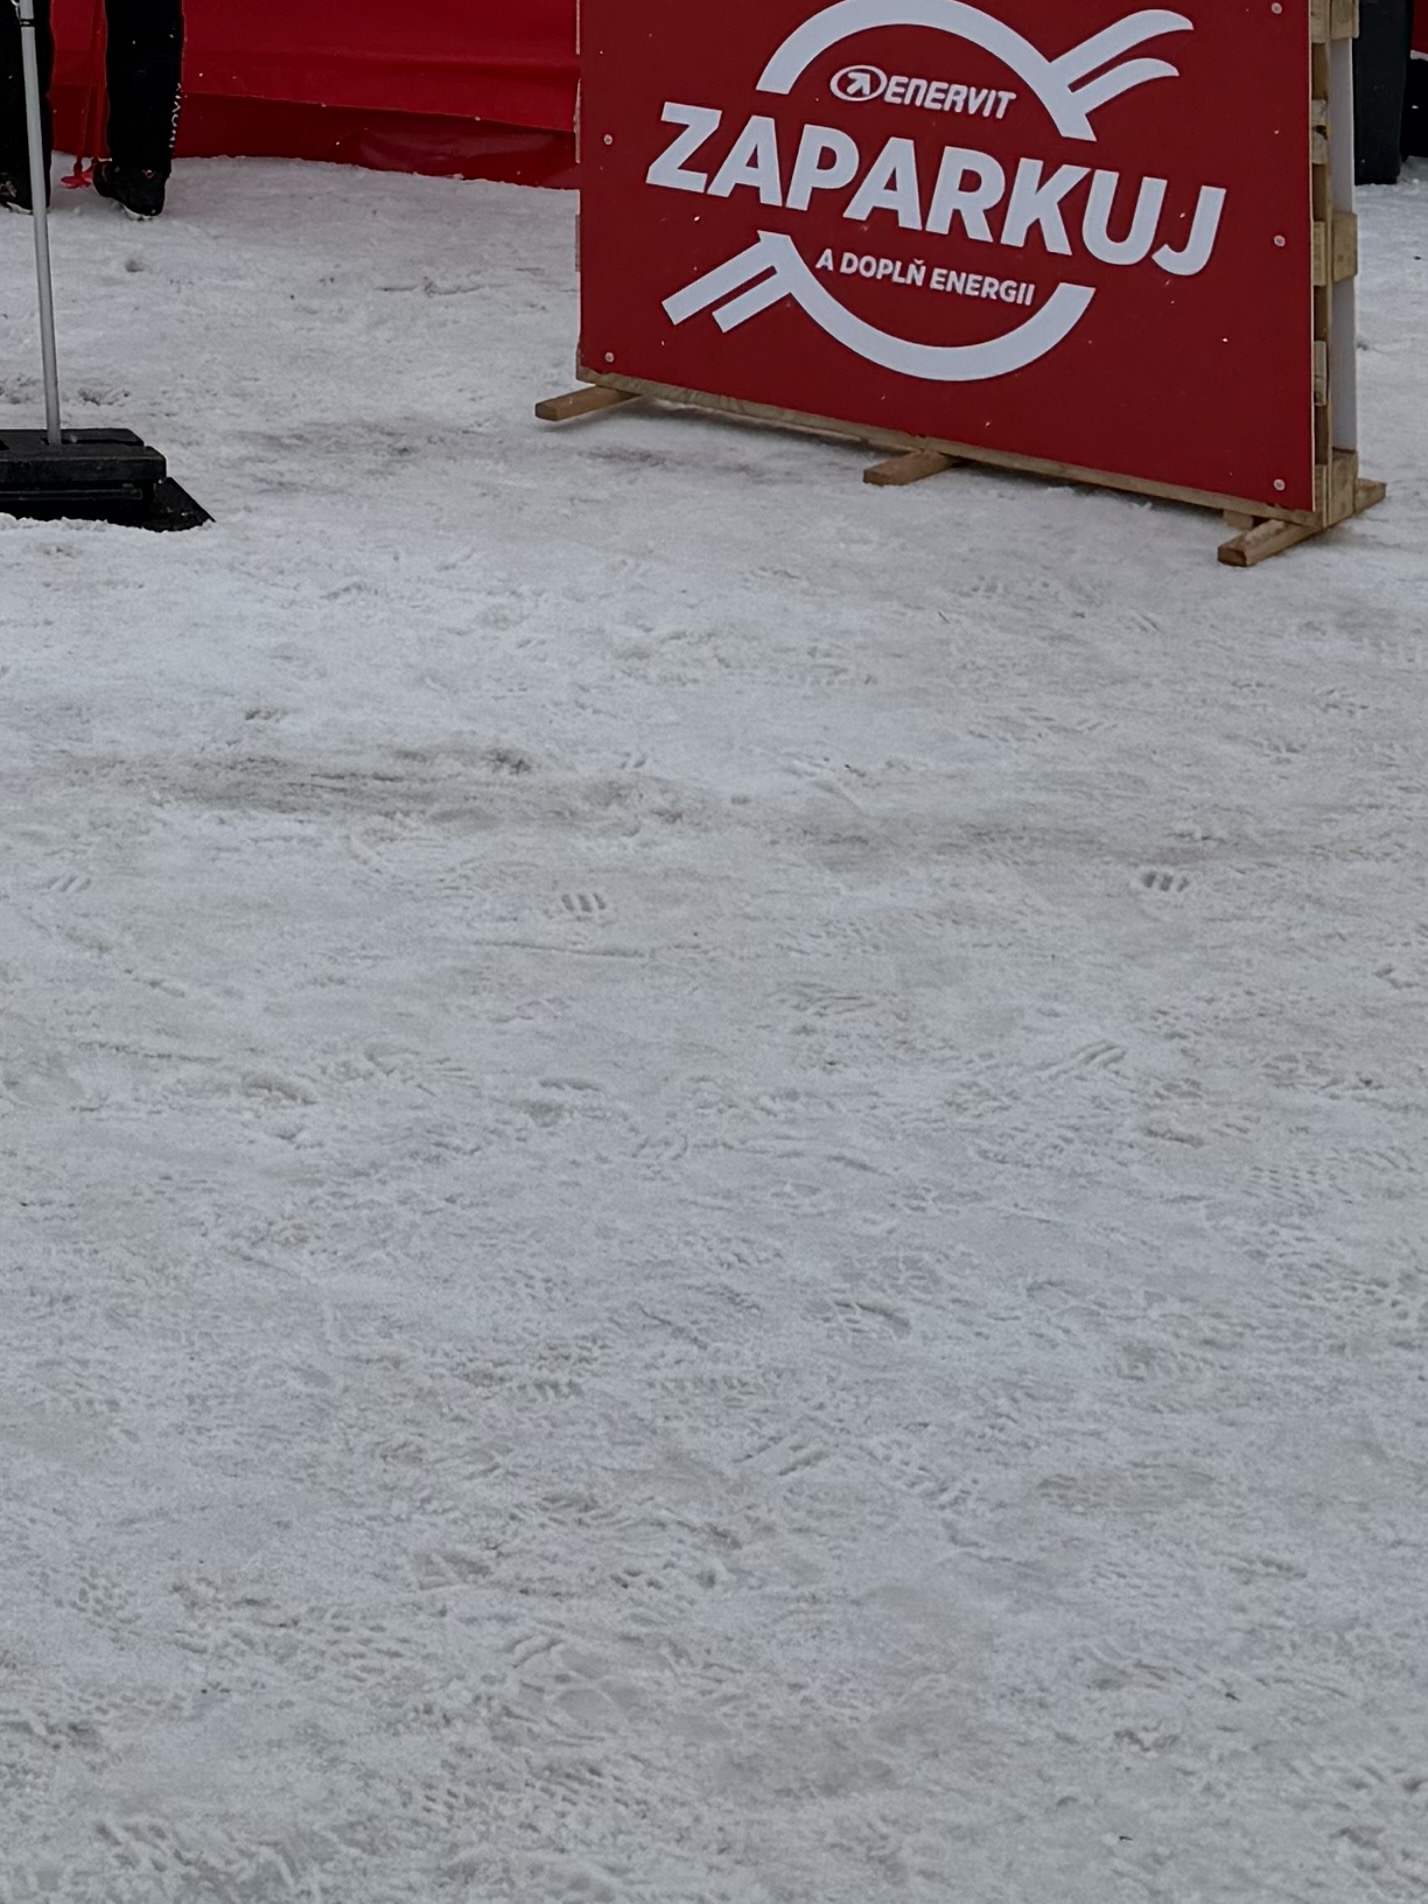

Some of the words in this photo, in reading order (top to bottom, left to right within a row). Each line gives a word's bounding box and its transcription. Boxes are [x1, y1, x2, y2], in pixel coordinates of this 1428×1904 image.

[884, 76, 1016, 120] ENERVIT
[646, 102, 1226, 276] ZAPARKUJ
[816, 249, 834, 271] A
[840, 251, 926, 287] DOPLŇ
[930, 267, 1035, 306] ENERGII
